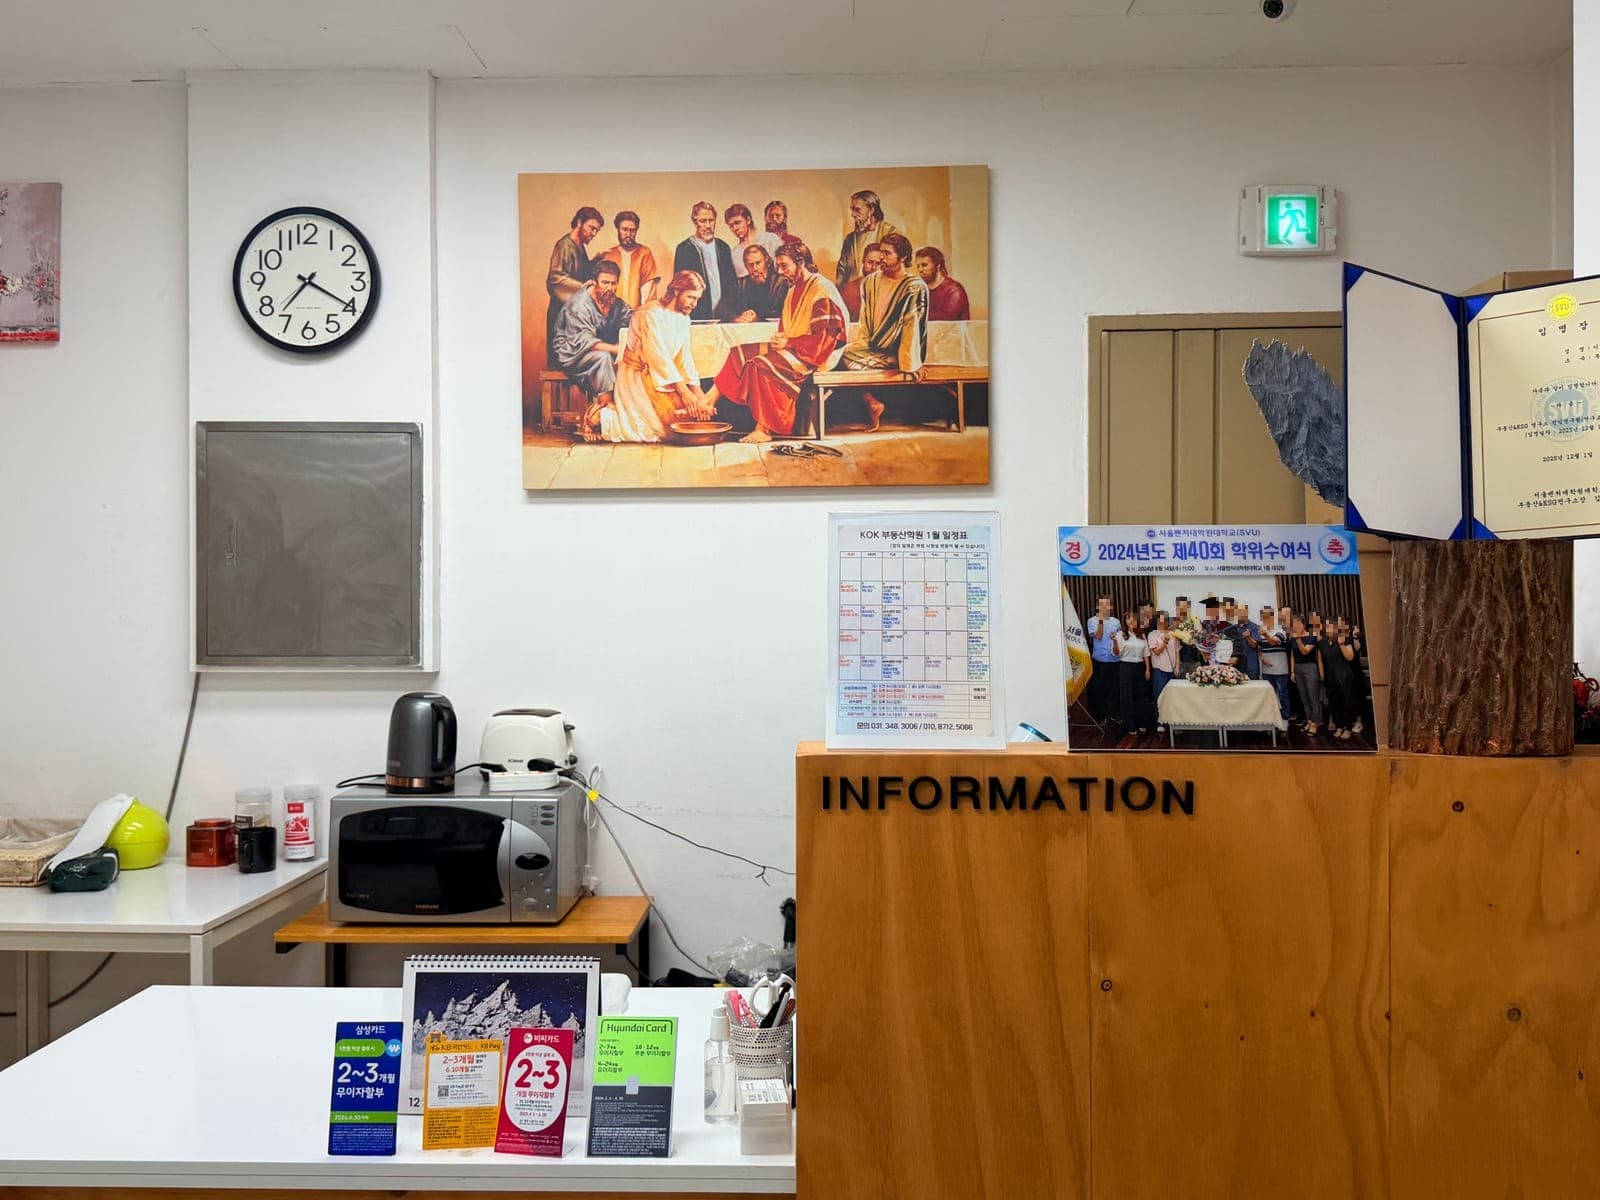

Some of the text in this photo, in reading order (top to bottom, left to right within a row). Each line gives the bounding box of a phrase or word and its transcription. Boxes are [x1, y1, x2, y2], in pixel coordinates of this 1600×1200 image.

[279, 230, 292, 251] 11
[297, 223, 318, 245] 12
[329, 230, 333, 251] 1
[259, 249, 282, 270] 10
[341, 245, 356, 266] 2
[250, 271, 266, 291] 9
[350, 271, 366, 292] 3
[259, 296, 274, 316] 8
[342, 297, 357, 316] 4
[279, 314, 292, 333] 7
[301, 321, 316, 340] 6
[325, 314, 340, 333] 5
[860, 530, 968, 540] KOK 부동산학원 1월 일정표
[1066, 541, 1081, 559] 경
[1098, 540, 1312, 560] 2024년도 제40회 학위수여식
[1327, 538, 1344, 557] 축
[822, 775, 1195, 815] INFORMATION
[356, 1025, 386, 1036] 삼성카드
[607, 1023, 667, 1034] Hyundai Card
[534, 1034, 560, 1043] 비씨카드
[337, 1062, 395, 1084] 2~3개월
[515, 1059, 560, 1089] 2~3
[336, 1087, 384, 1099] 무이자할부
[408, 1097, 420, 1107] 12
[528, 1091, 555, 1099] 무이자할부
